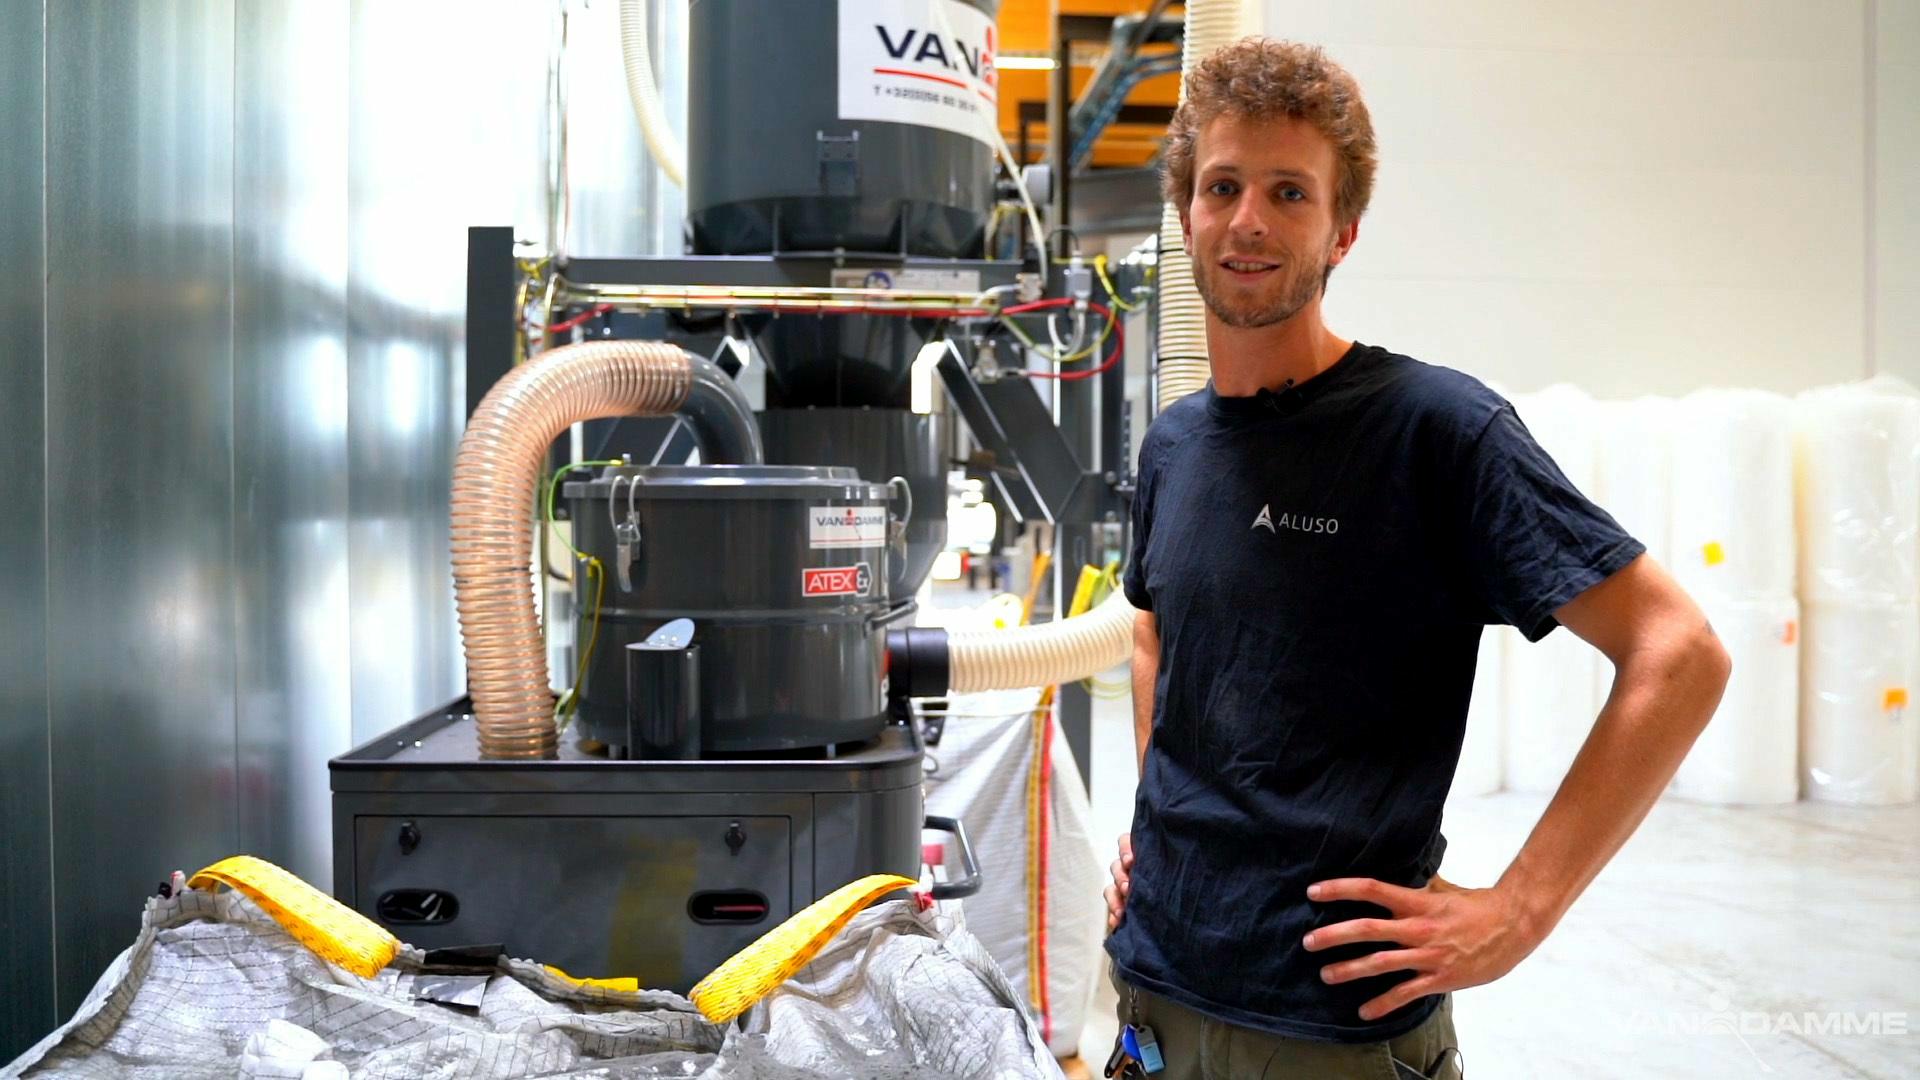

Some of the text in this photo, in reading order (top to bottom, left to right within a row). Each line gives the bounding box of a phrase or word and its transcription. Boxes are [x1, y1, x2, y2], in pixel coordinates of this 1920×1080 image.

[816, 516, 843, 526] VAN
[1278, 512, 1339, 534] ALUSO
[807, 572, 854, 592] ATEX
